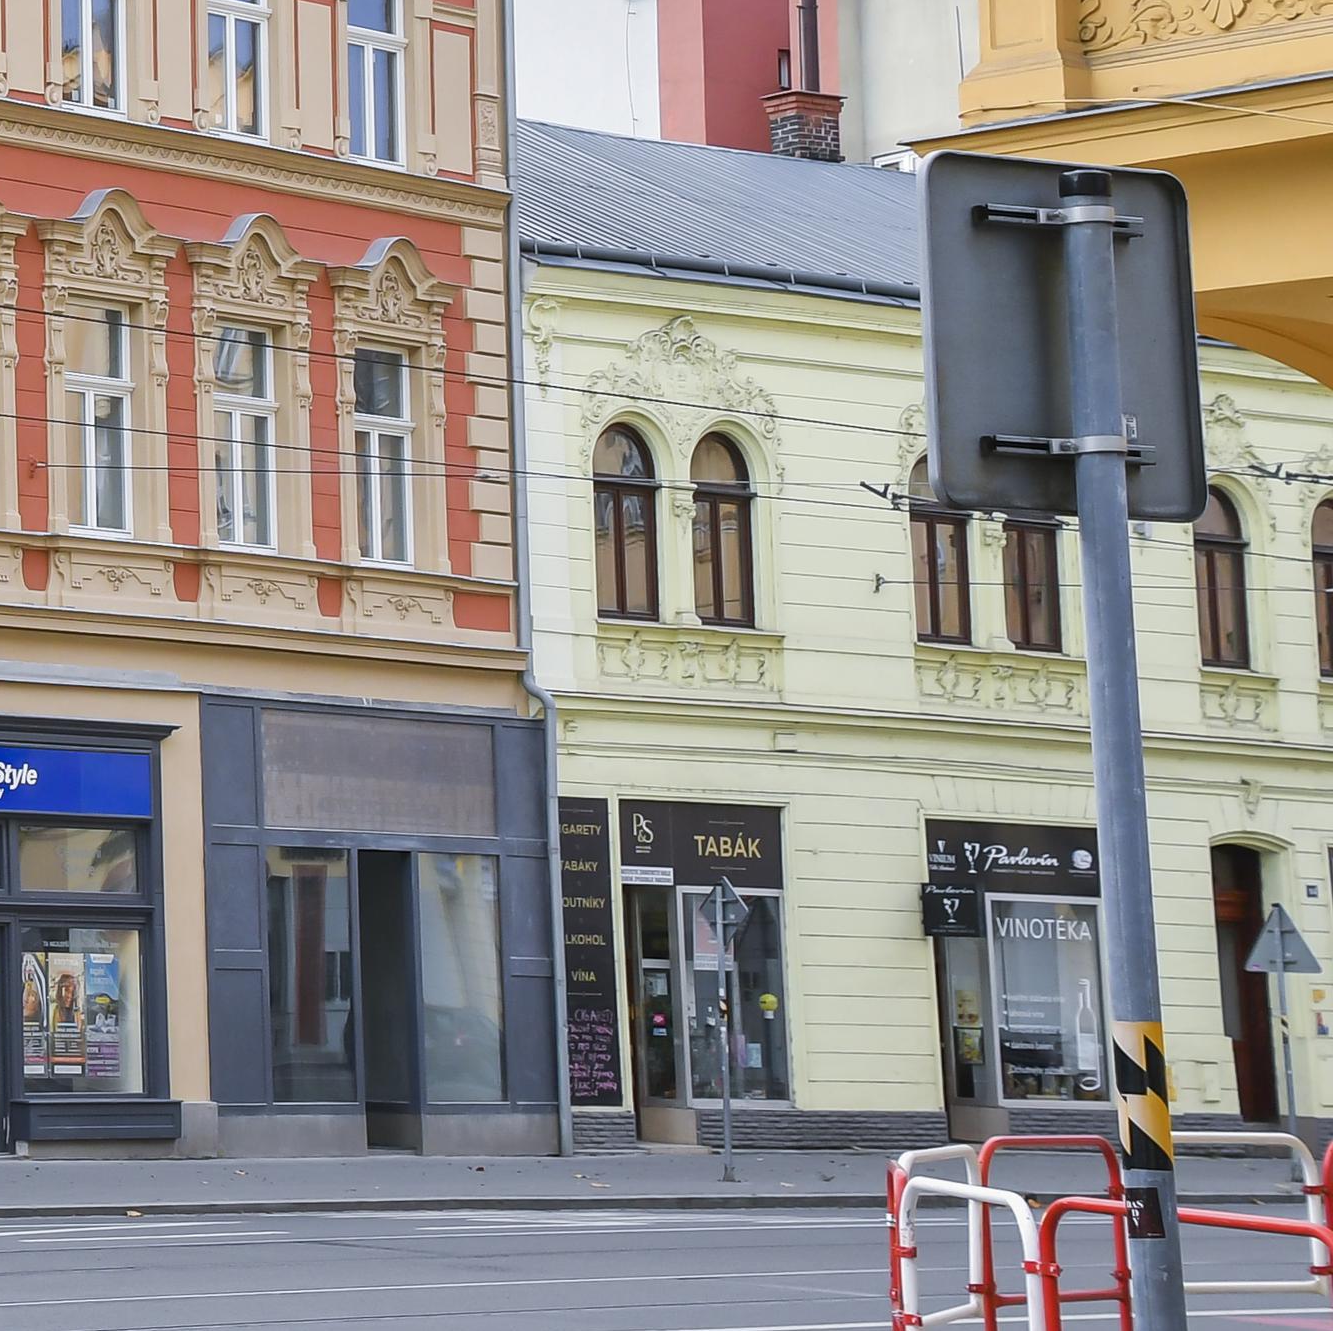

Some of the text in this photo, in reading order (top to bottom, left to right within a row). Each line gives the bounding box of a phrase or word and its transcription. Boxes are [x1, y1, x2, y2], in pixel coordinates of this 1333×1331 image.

[559, 823, 602, 836] GARETY
[693, 832, 762, 859] TABÁK
[983, 845, 1060, 871] Pavlovín
[562, 895, 606, 909] OUTNÍKY
[996, 916, 1092, 941] VINOTÉKA
[564, 934, 606, 945] LKOHOL
[571, 970, 597, 982] VÍNA
